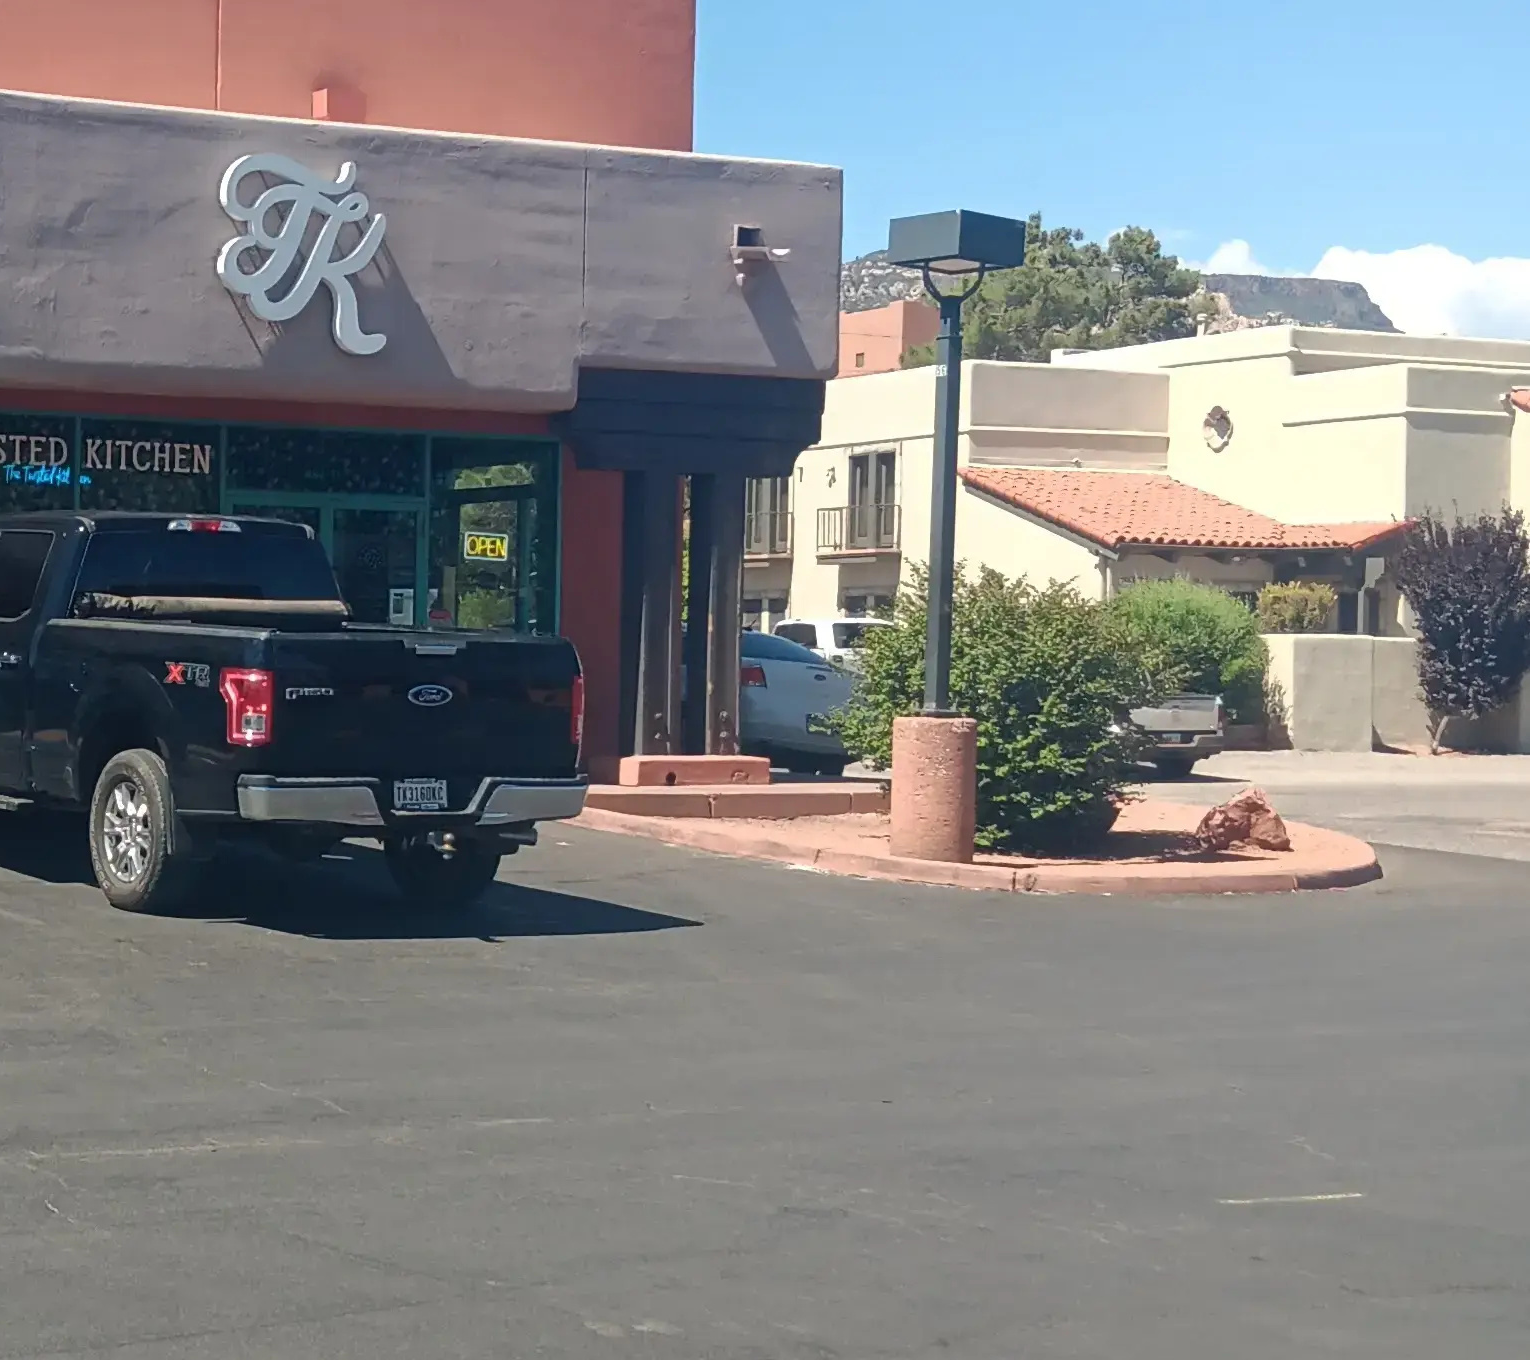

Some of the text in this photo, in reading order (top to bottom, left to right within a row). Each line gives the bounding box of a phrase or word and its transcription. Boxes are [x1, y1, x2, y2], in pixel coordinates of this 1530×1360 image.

[85, 439, 212, 475] KITCHEN
[3, 464, 21, 483] The
[467, 536, 506, 557] OPEN
[162, 661, 211, 685] XTR
[418, 688, 444, 701] Ford
